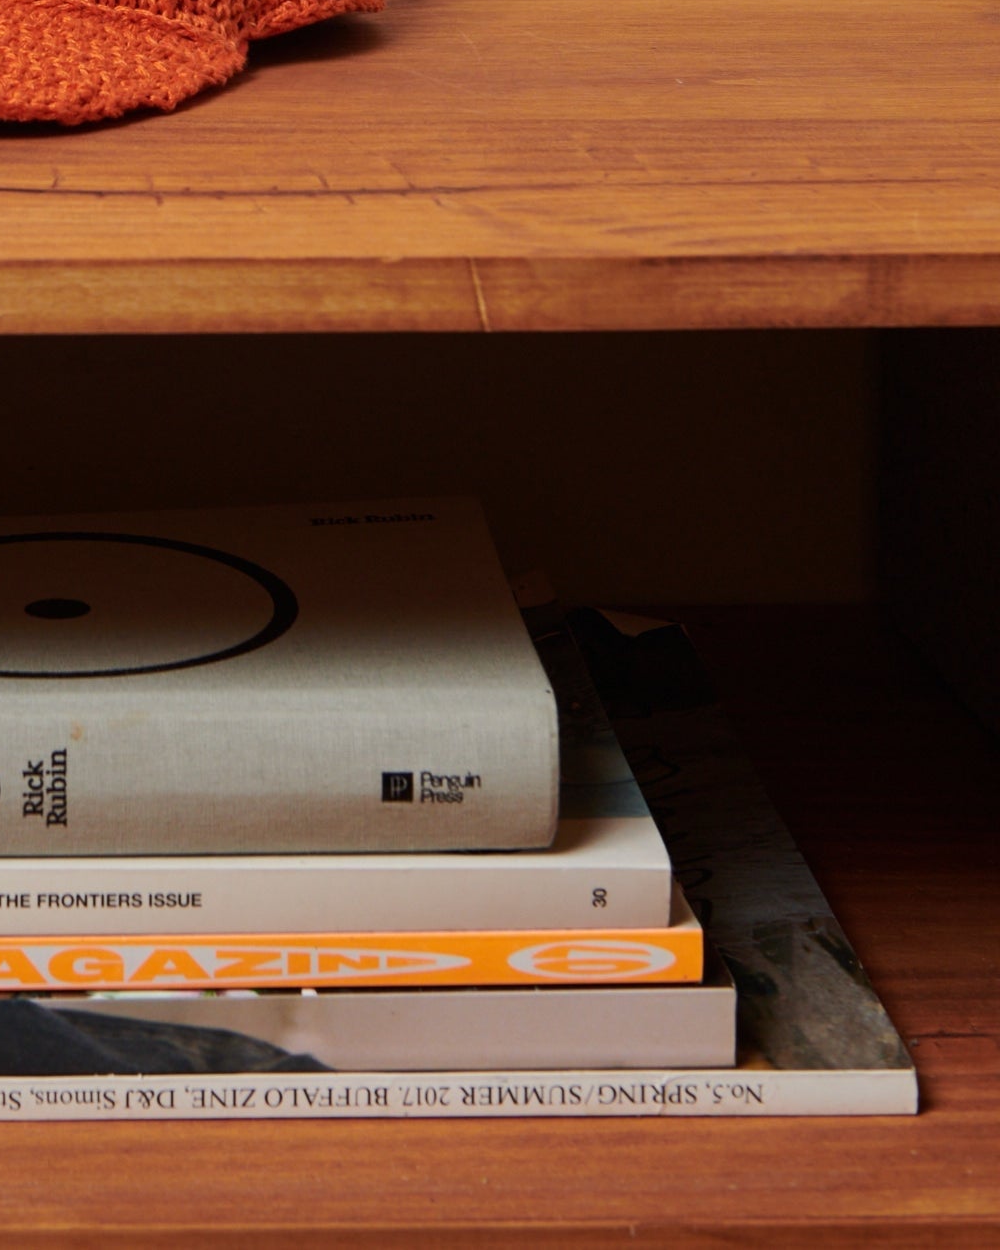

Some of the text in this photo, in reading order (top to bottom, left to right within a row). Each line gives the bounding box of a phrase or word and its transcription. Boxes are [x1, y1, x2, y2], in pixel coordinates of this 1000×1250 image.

[22, 759, 44, 818] Rick
[46, 747, 68, 828] Rubin
[420, 770, 482, 791] Penguin
[420, 788, 464, 804] Press
[36, 893, 143, 909] FRONTIERS
[148, 893, 202, 908] ISSUE
[591, 887, 608, 908] 30
[30, 1087, 116, 1111] Simons,
[125, 1089, 175, 1110] D&J
[184, 1087, 257, 1110] ZINE,
[264, 1088, 390, 1109] BUFFALO
